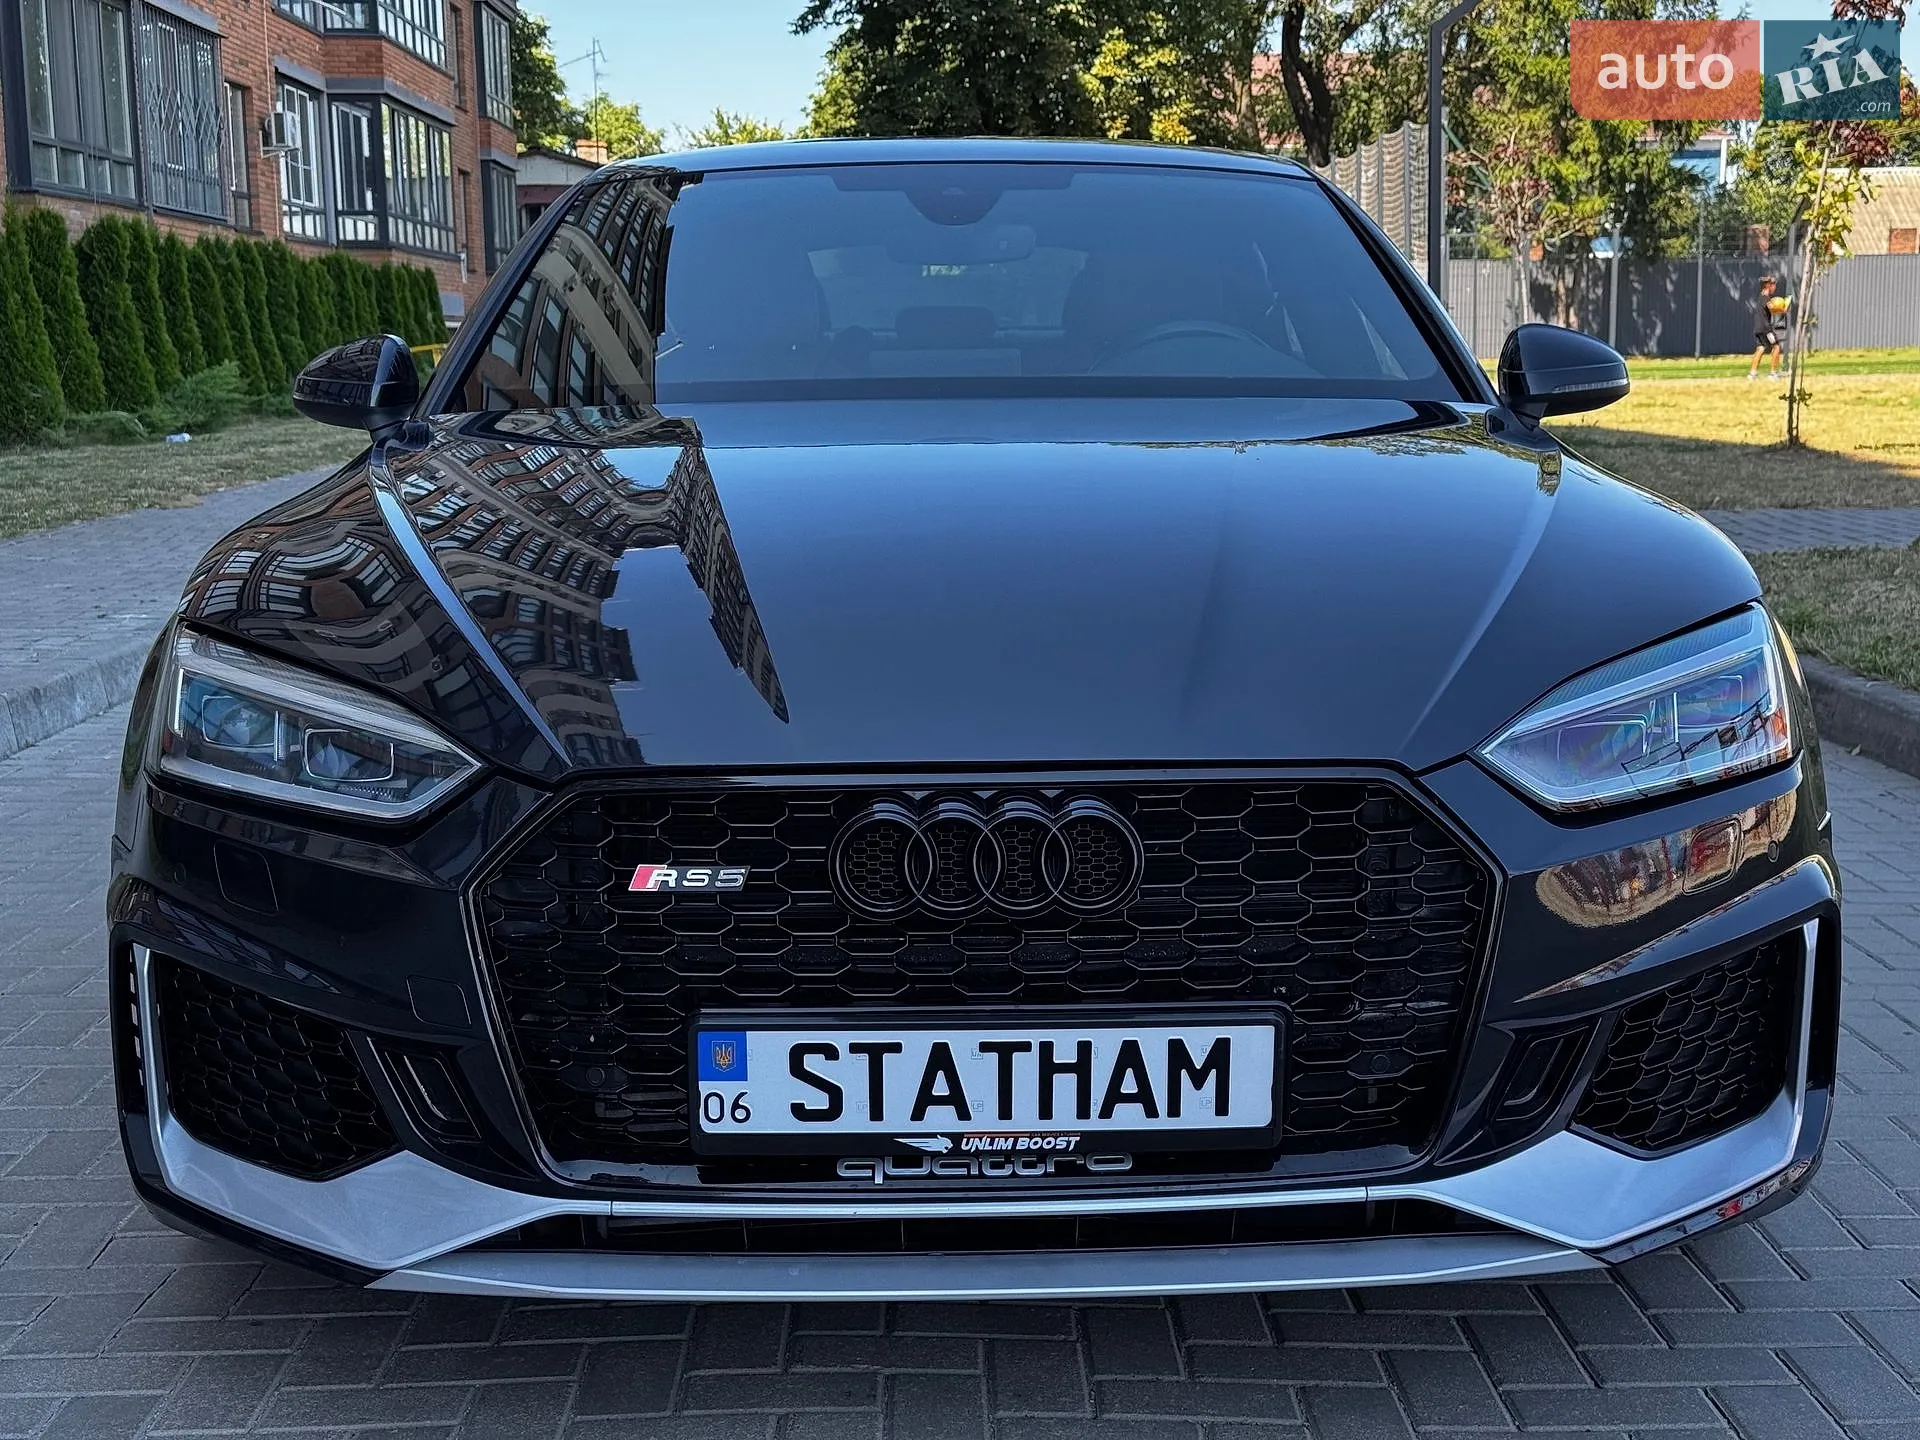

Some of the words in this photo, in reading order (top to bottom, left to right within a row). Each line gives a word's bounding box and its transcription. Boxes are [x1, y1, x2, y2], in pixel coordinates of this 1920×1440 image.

[645, 868, 747, 888] RS5
[789, 1036, 1232, 1123] STATHAM
[703, 1091, 752, 1124] 06
[961, 1135, 1014, 1152] UNLIM
[1016, 1136, 1081, 1152] BOOST
[836, 1152, 1133, 1185] quattro
